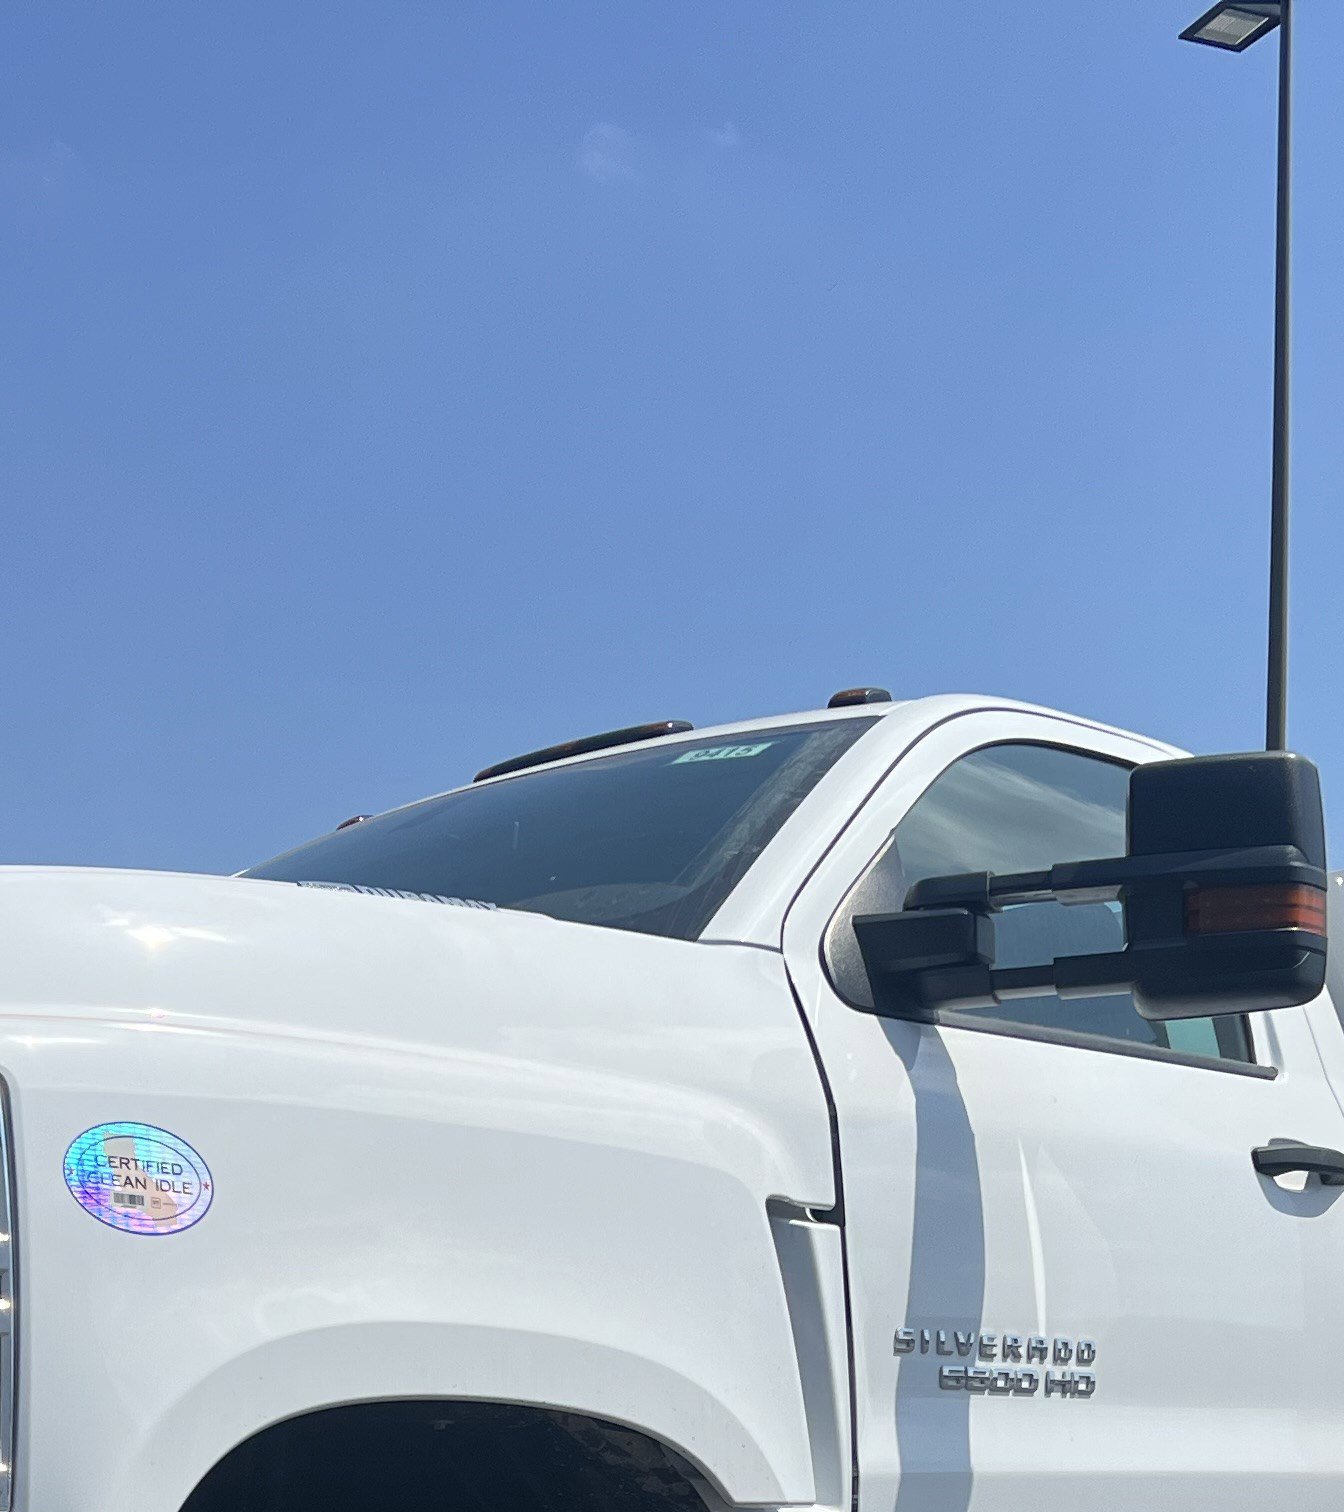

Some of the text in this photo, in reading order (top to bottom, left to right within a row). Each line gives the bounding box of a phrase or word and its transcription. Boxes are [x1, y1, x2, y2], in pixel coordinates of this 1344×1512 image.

[94, 1155, 183, 1176] CERTIFIED
[86, 1170, 194, 1195] CLEAN IDLE
[893, 1327, 1096, 1366] SILVERADO
[1045, 1368, 1096, 1398] HD
